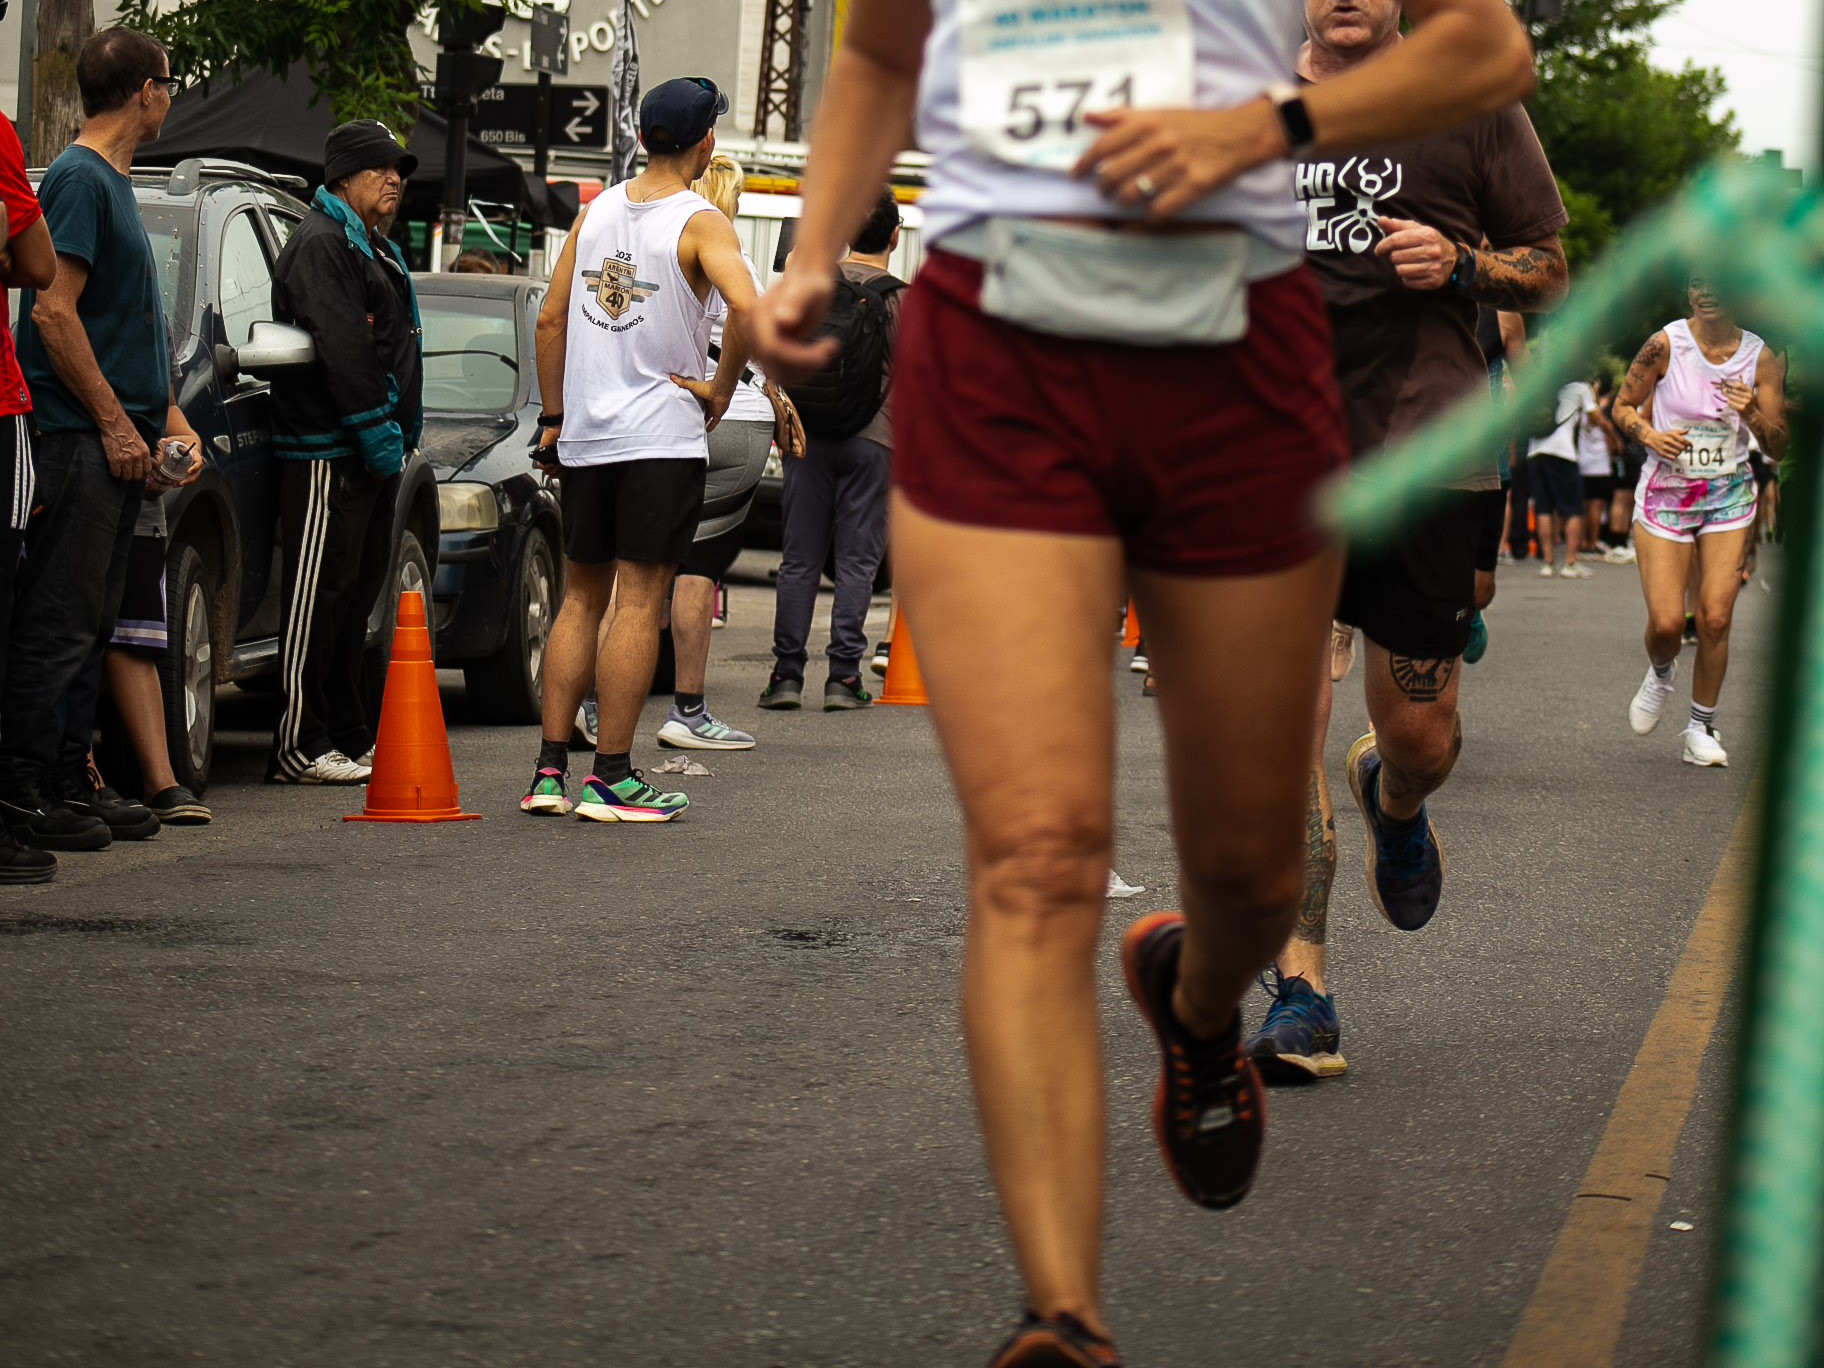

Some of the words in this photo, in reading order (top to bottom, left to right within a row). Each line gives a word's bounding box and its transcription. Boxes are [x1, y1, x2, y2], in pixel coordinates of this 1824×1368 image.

[1005, 74, 1134, 142] 571
[480, 129, 503, 143] 650
[505, 130, 526, 144] Bis
[605, 291, 625, 310] 40
[1685, 447, 1725, 467] 104
